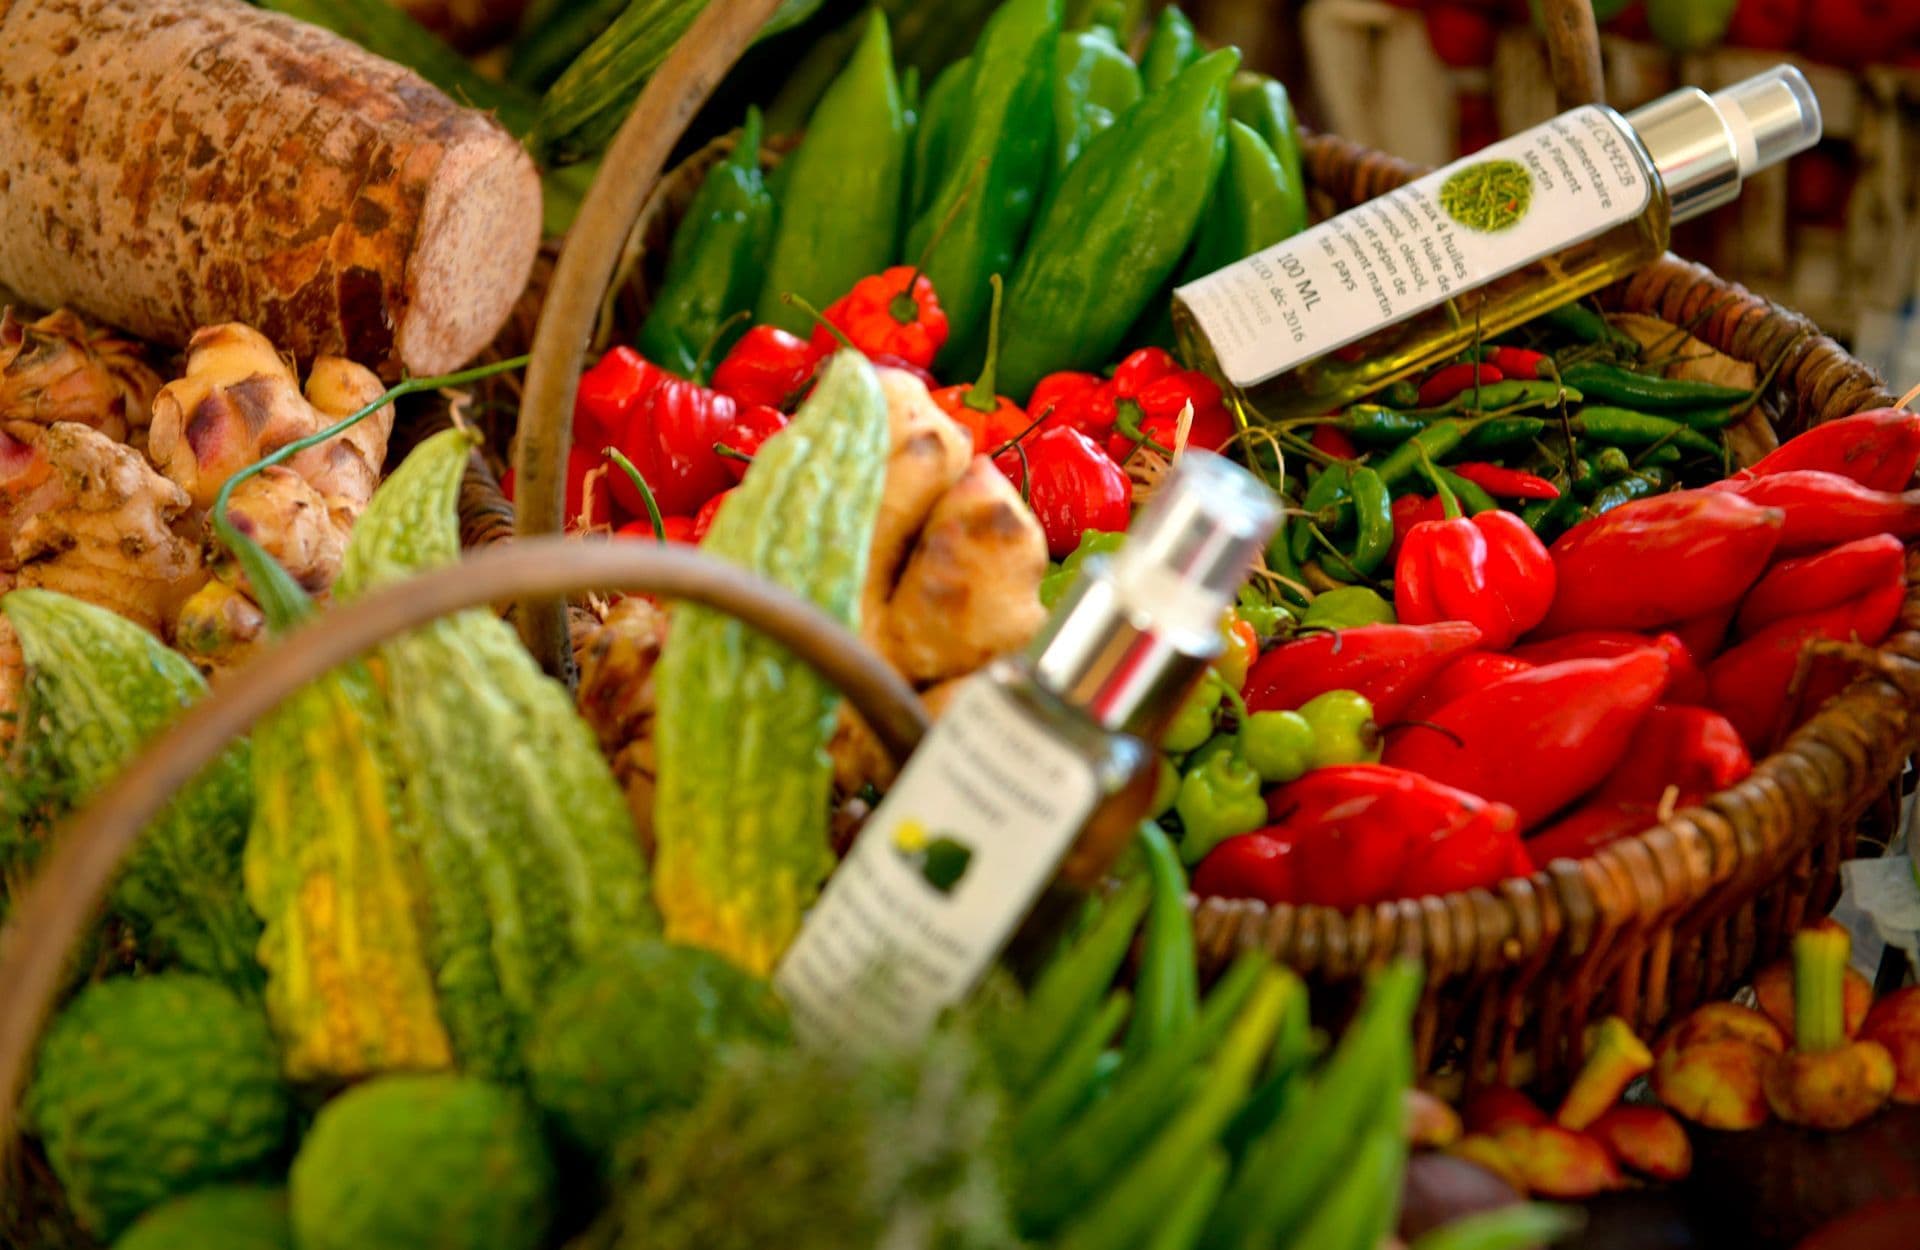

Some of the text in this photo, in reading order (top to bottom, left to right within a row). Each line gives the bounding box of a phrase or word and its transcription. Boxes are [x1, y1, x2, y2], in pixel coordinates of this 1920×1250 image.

[1523, 149, 1554, 191] Martin
[1550, 146, 1582, 195] Piment
[1565, 135, 1612, 208] alimentaire
[1365, 228, 1378, 240] et
[1370, 239, 1397, 275] pépin
[1420, 201, 1467, 280] aux 4 huiles
[1277, 252, 1321, 312] 100 ML
[1331, 258, 1358, 292] pays
[1341, 232, 1393, 318] piment martin
[1392, 276, 1406, 296] de
[1420, 236, 1442, 272] Huile
[1437, 273, 1450, 292] de
[1270, 286, 1287, 307] déc
[1282, 309, 1304, 343] 2016
